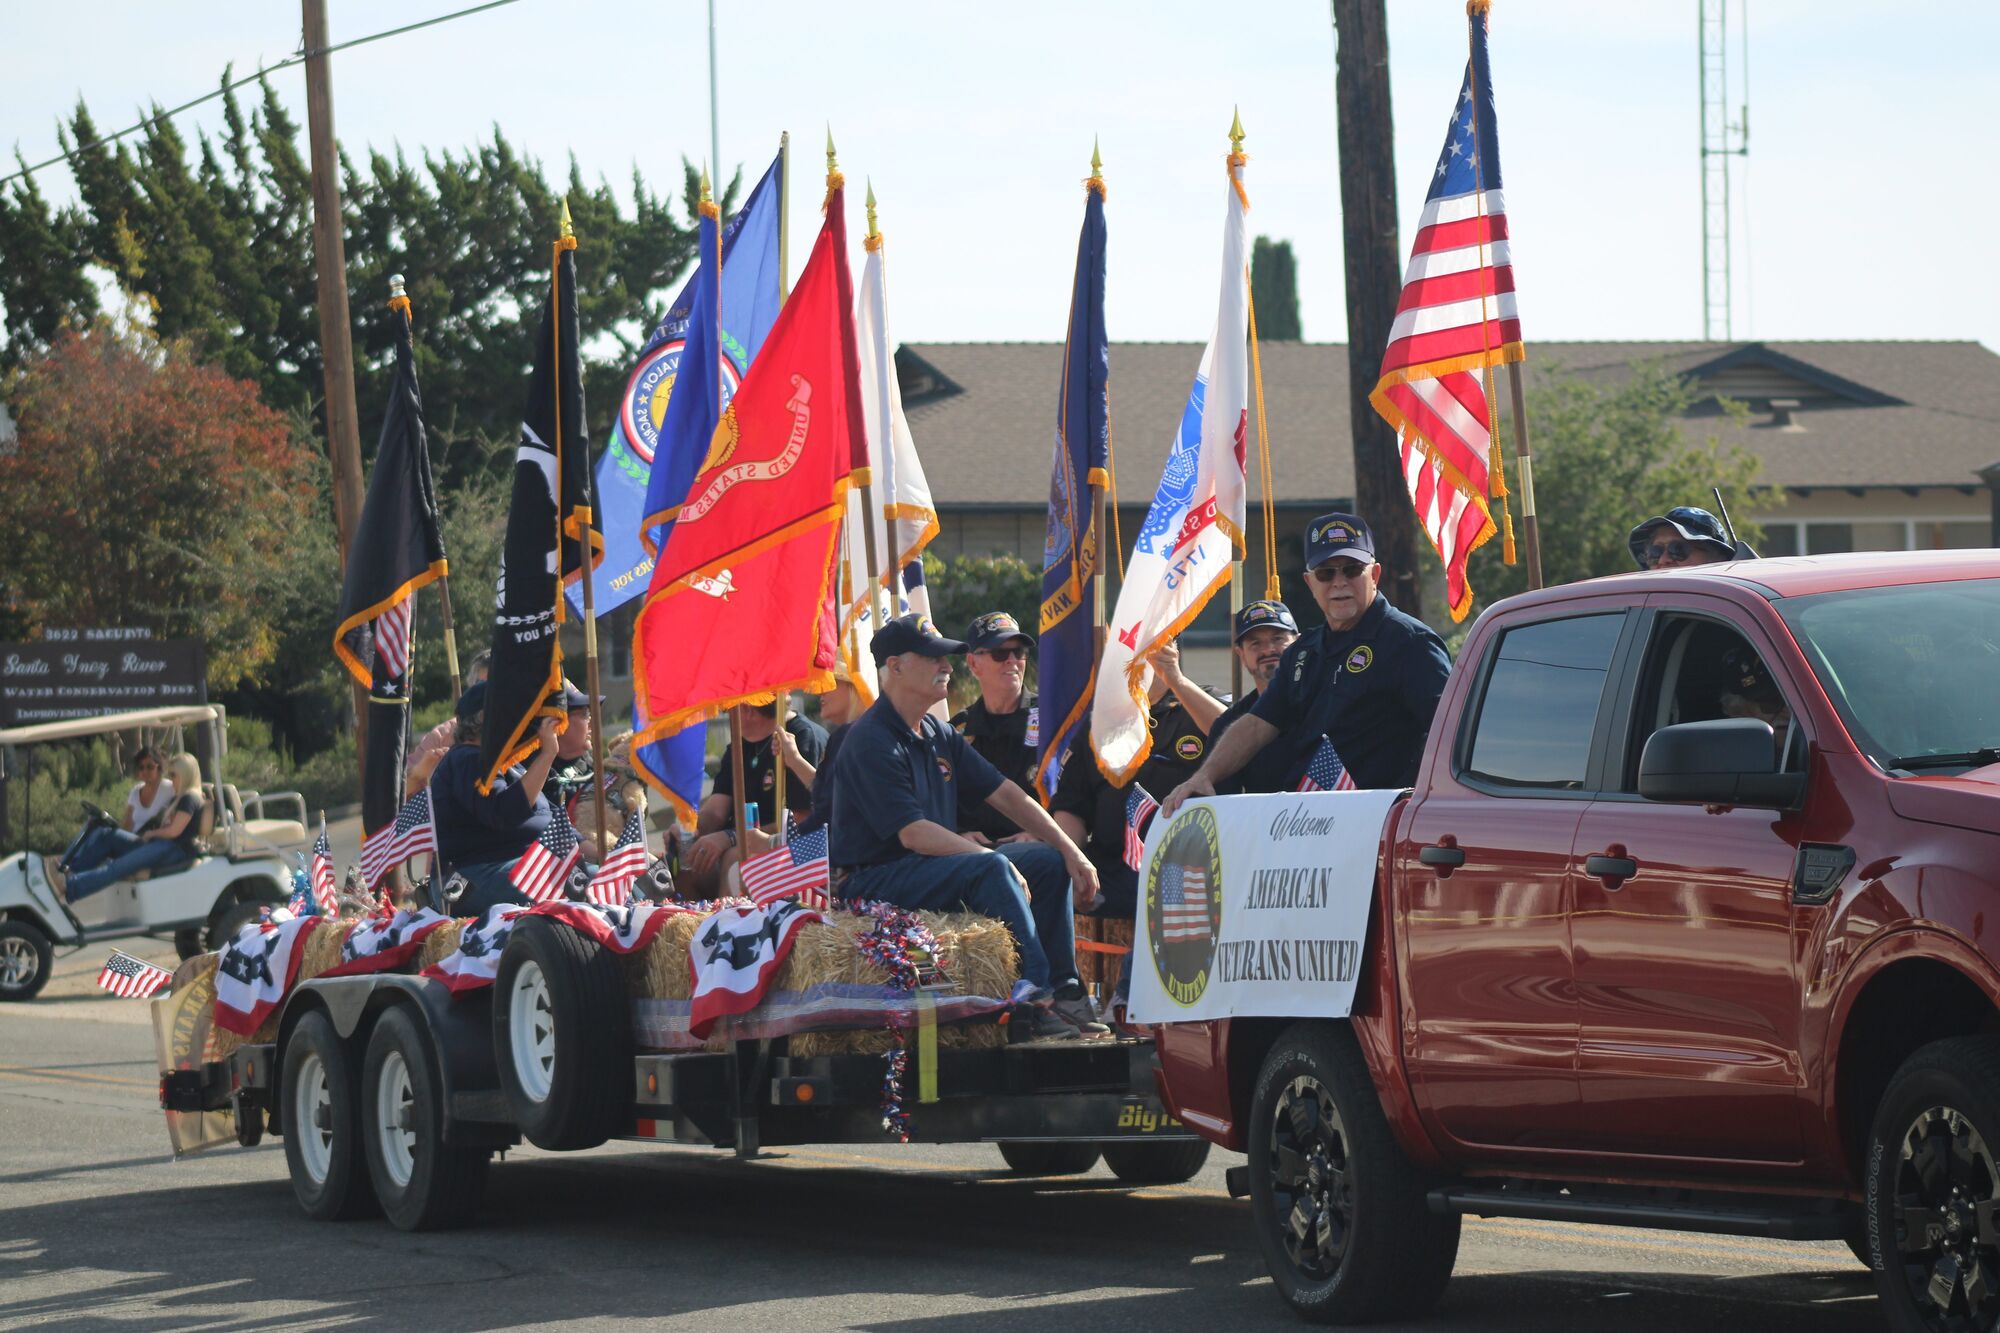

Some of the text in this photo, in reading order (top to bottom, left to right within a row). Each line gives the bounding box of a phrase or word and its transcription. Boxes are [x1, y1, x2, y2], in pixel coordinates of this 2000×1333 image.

[515, 629, 540, 643] YOU
[3, 652, 167, 679] Santa Ynez River
[5, 686, 54, 698] WATER
[58, 685, 157, 697] CONSERVATION
[1269, 801, 1335, 842] Welcome
[1146, 809, 1194, 909] AMERICAN
[1243, 867, 1333, 909] AMERICAN
[1217, 940, 1360, 983] VETERANS UNITED
[1168, 969, 1207, 1003] UNITED
[1118, 1105, 1157, 1132] Big
